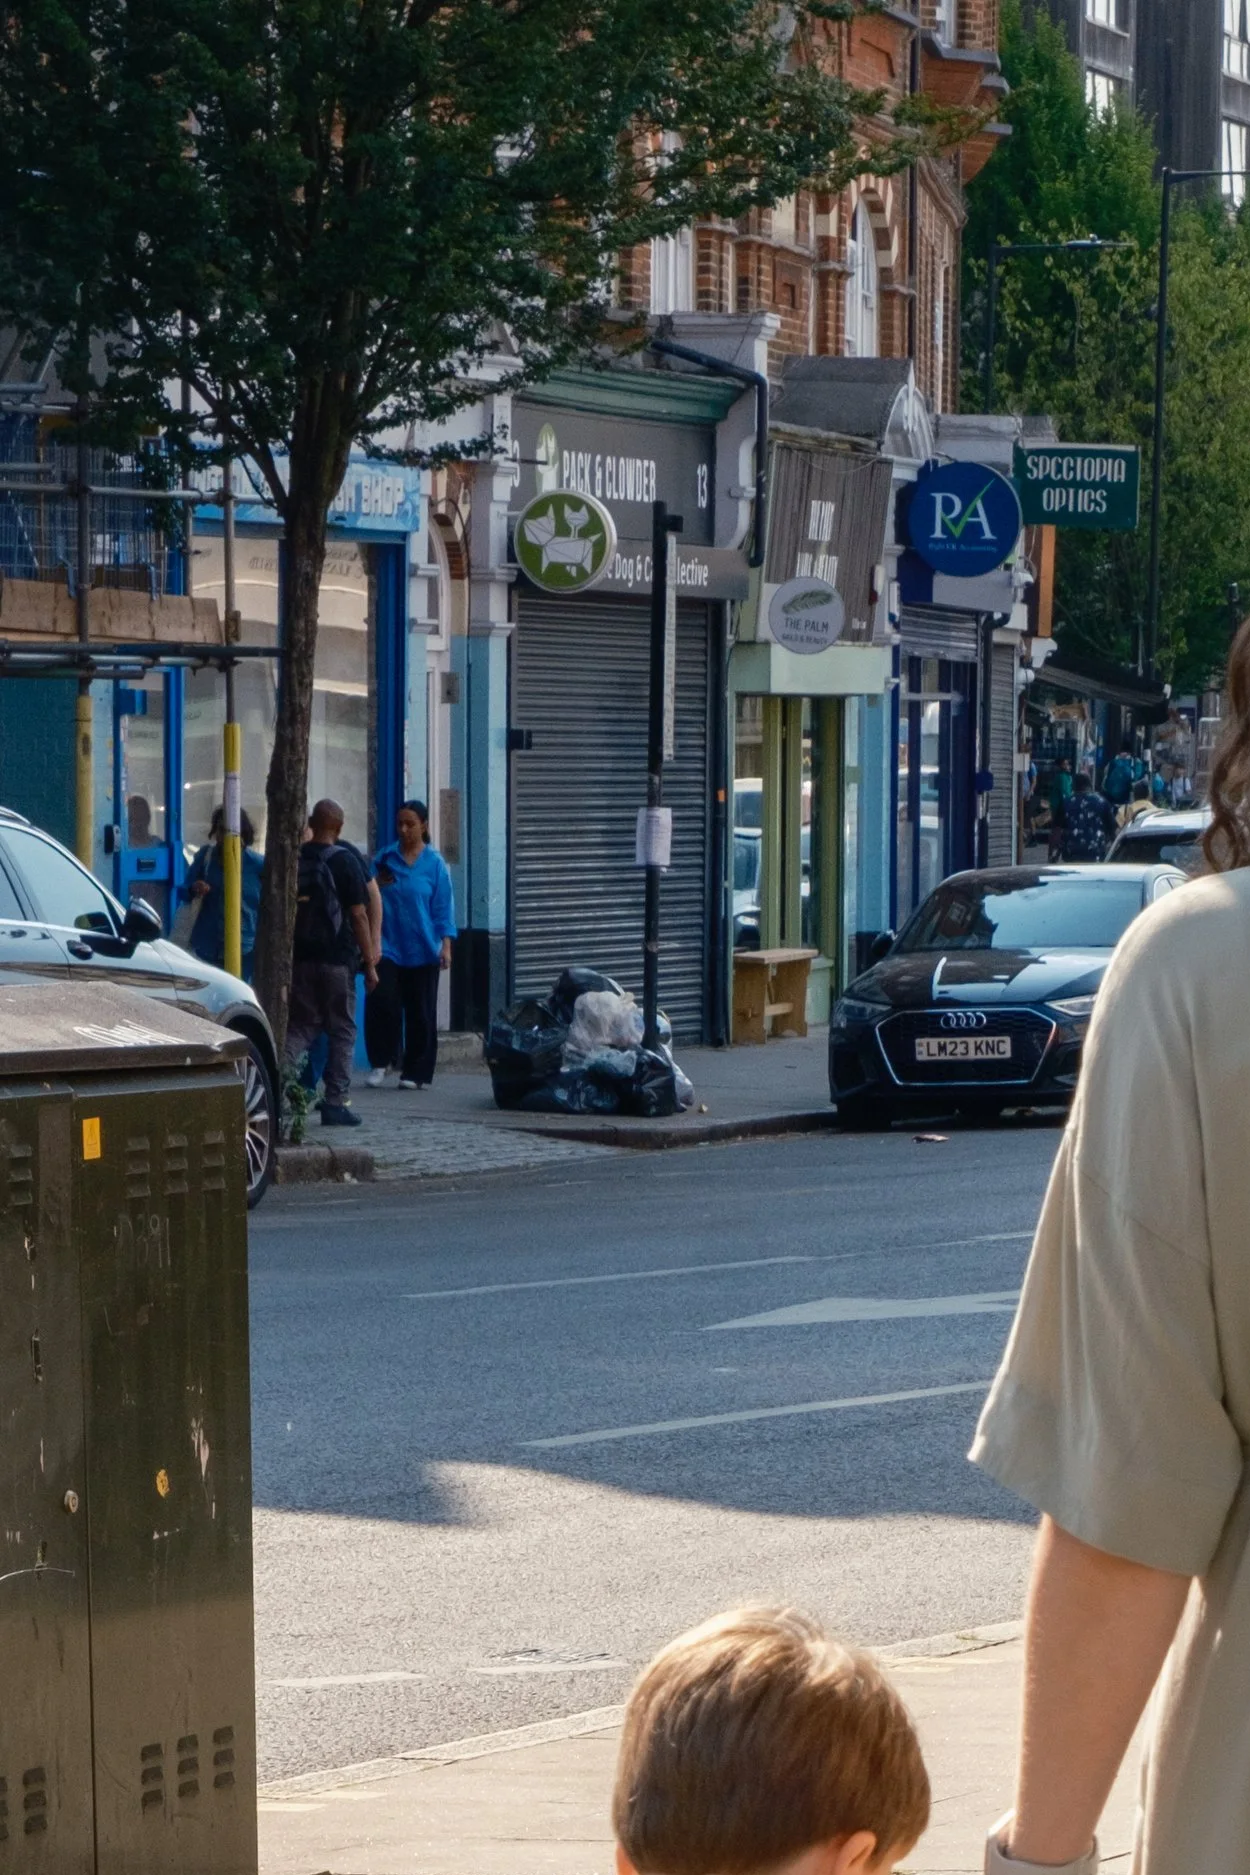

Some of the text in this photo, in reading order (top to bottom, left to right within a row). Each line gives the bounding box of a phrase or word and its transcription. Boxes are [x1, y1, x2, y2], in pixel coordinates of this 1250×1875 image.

[563, 450, 657, 503] PACK & CLOWDER
[697, 463, 708, 509] 13
[1042, 487, 1108, 514] OPTICS
[615, 553, 633, 588] Dog
[636, 555, 642, 582] &
[784, 617, 829, 633] THE PALM
[926, 1040, 1006, 1057] LM23 KNC
